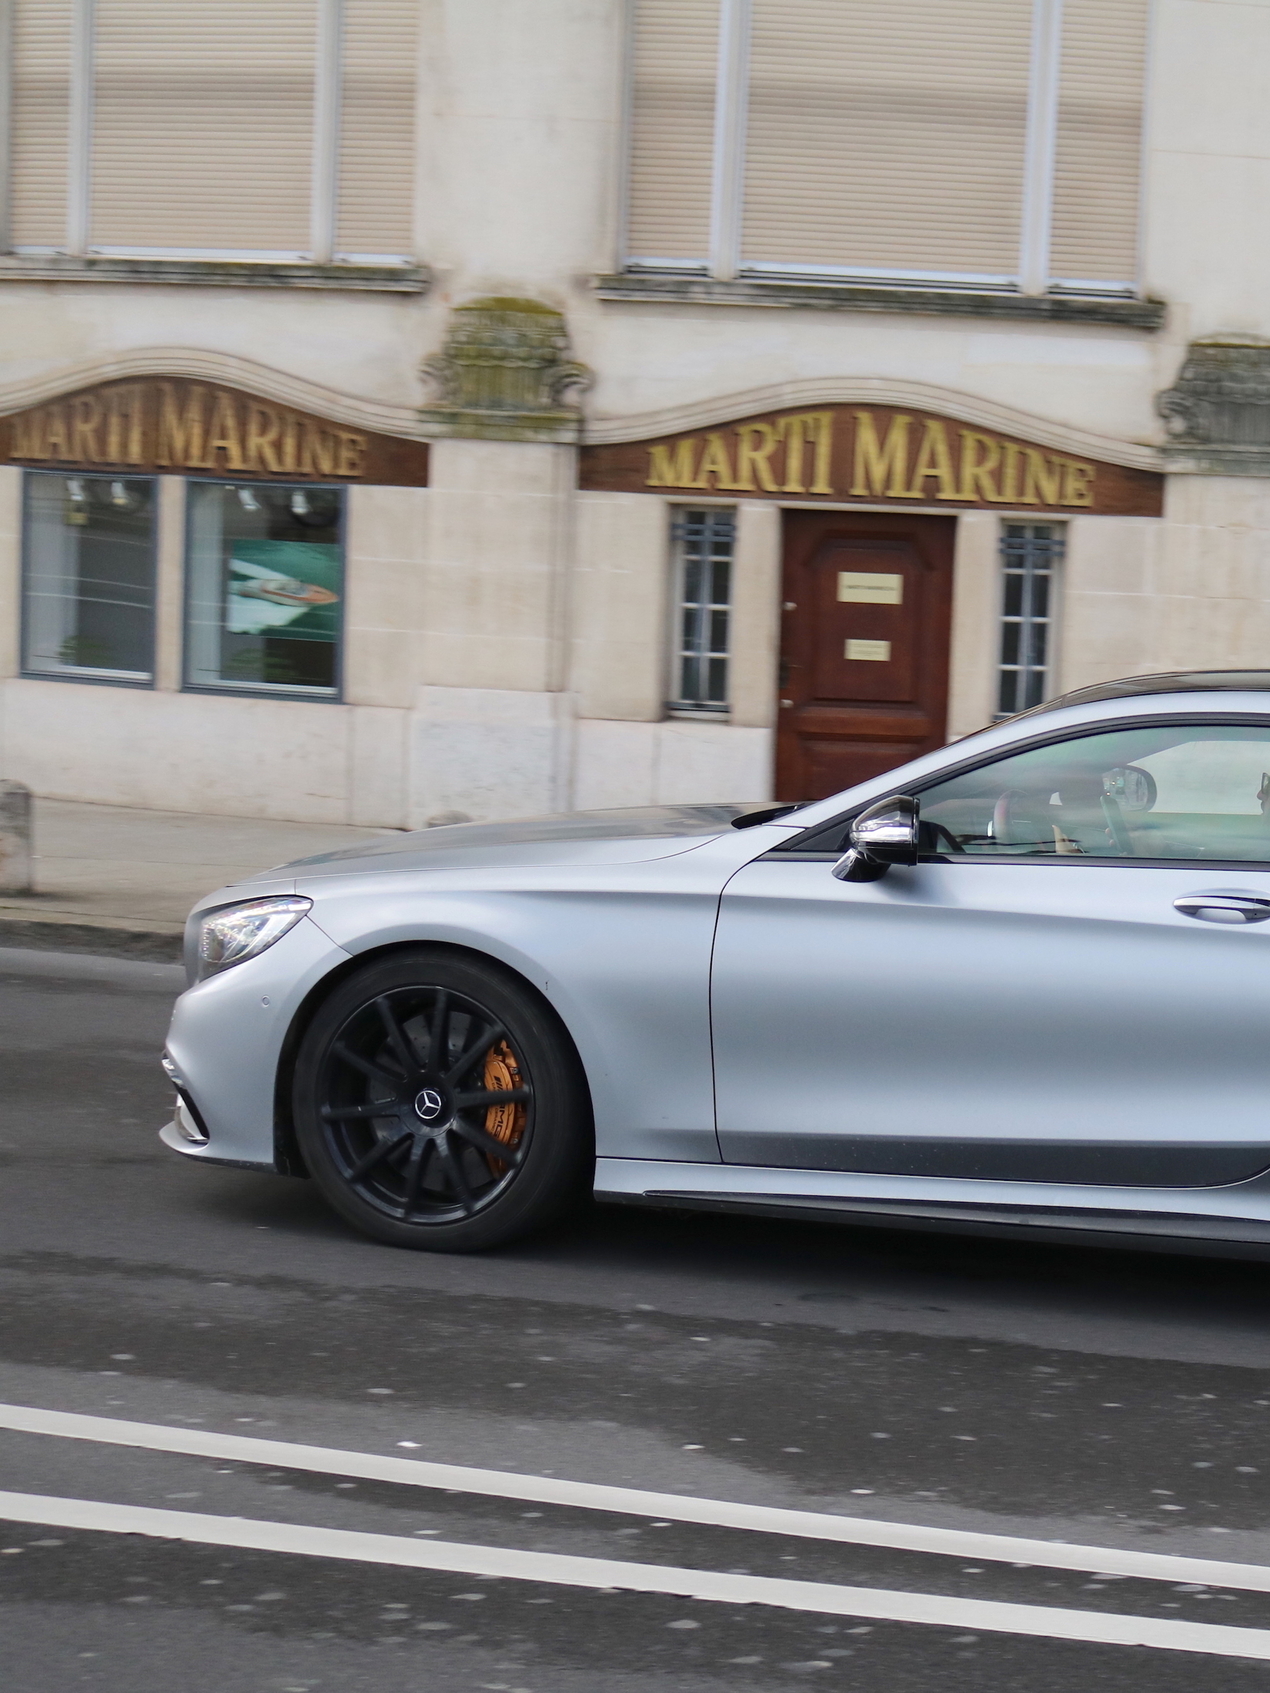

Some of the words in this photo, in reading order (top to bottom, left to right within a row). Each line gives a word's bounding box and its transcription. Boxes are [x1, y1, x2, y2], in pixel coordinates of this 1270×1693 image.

[8, 384, 146, 465] MARTI
[154, 383, 369, 478] MARINE
[644, 411, 834, 495] MARTI
[849, 411, 1096, 508] MARINE
